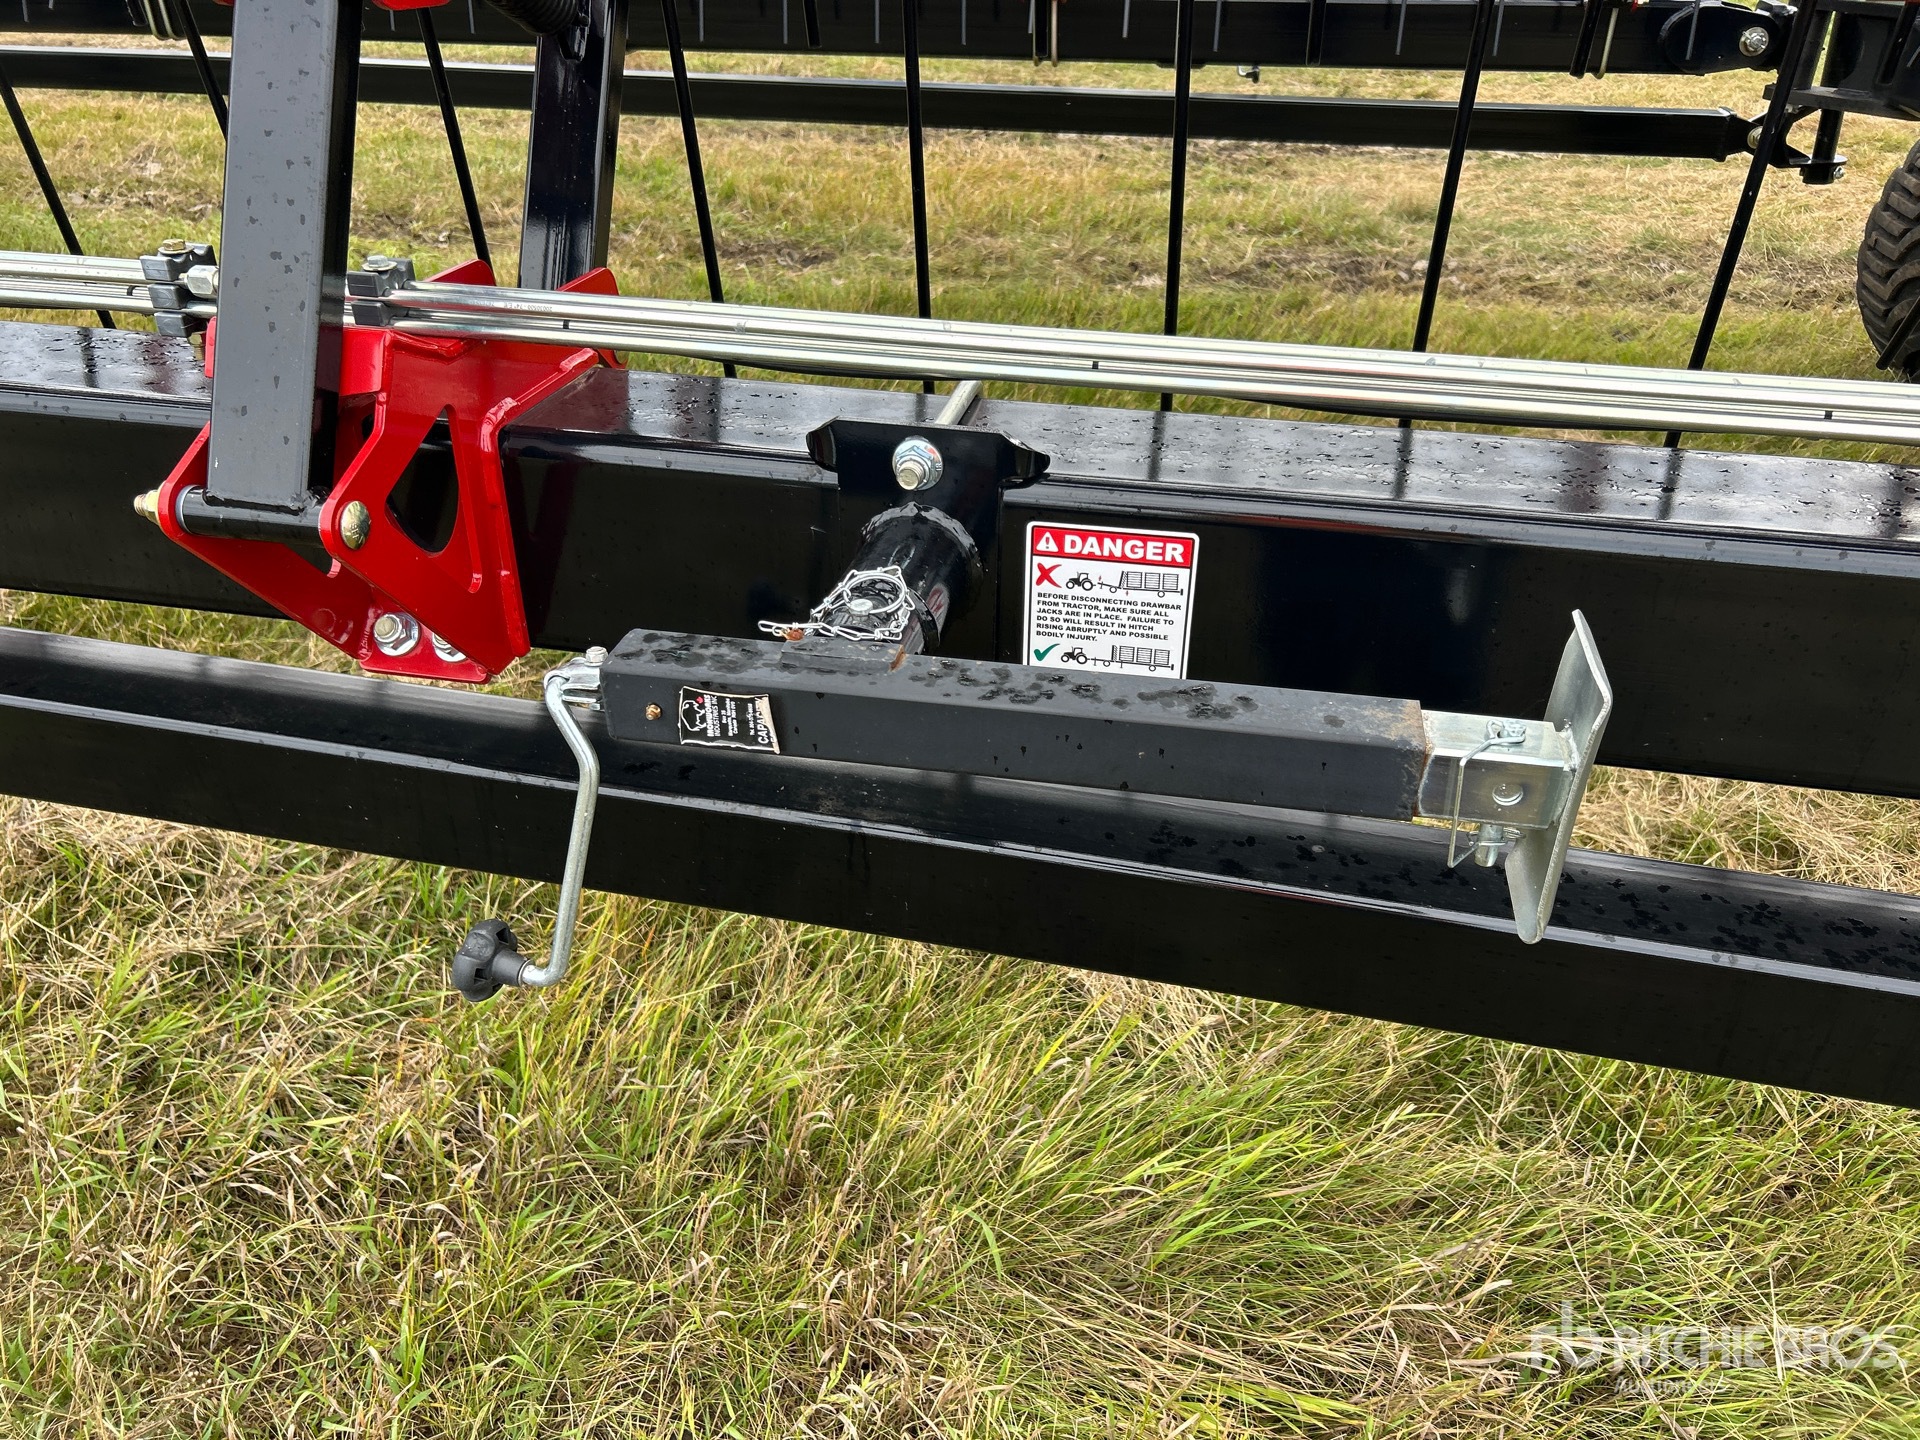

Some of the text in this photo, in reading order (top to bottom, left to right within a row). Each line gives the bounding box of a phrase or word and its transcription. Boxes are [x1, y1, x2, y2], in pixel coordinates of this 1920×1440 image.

[1064, 534, 1185, 563] DANGER
[1037, 592, 1182, 611] BEFORE DISCONNECTING DRAWBAR
[1037, 600, 1169, 618] FROM TRACTOR, MAKE SURE ALL
[1037, 607, 1063, 616] JACKS
[1094, 613, 1123, 621] PLACE.
[1127, 616, 1161, 625] FAILURE
[1063, 617, 1082, 625] WILL
[1084, 619, 1116, 628] RESULT
[1128, 623, 1154, 632] HITCH
[1036, 622, 1169, 641] RISING ABRUPTLY AND POSSIBLE
[1036, 630, 1098, 642] BODILY INJURY.
[703, 694, 714, 737] IRONWORKS
[713, 705, 721, 736] INDUSTRIES
